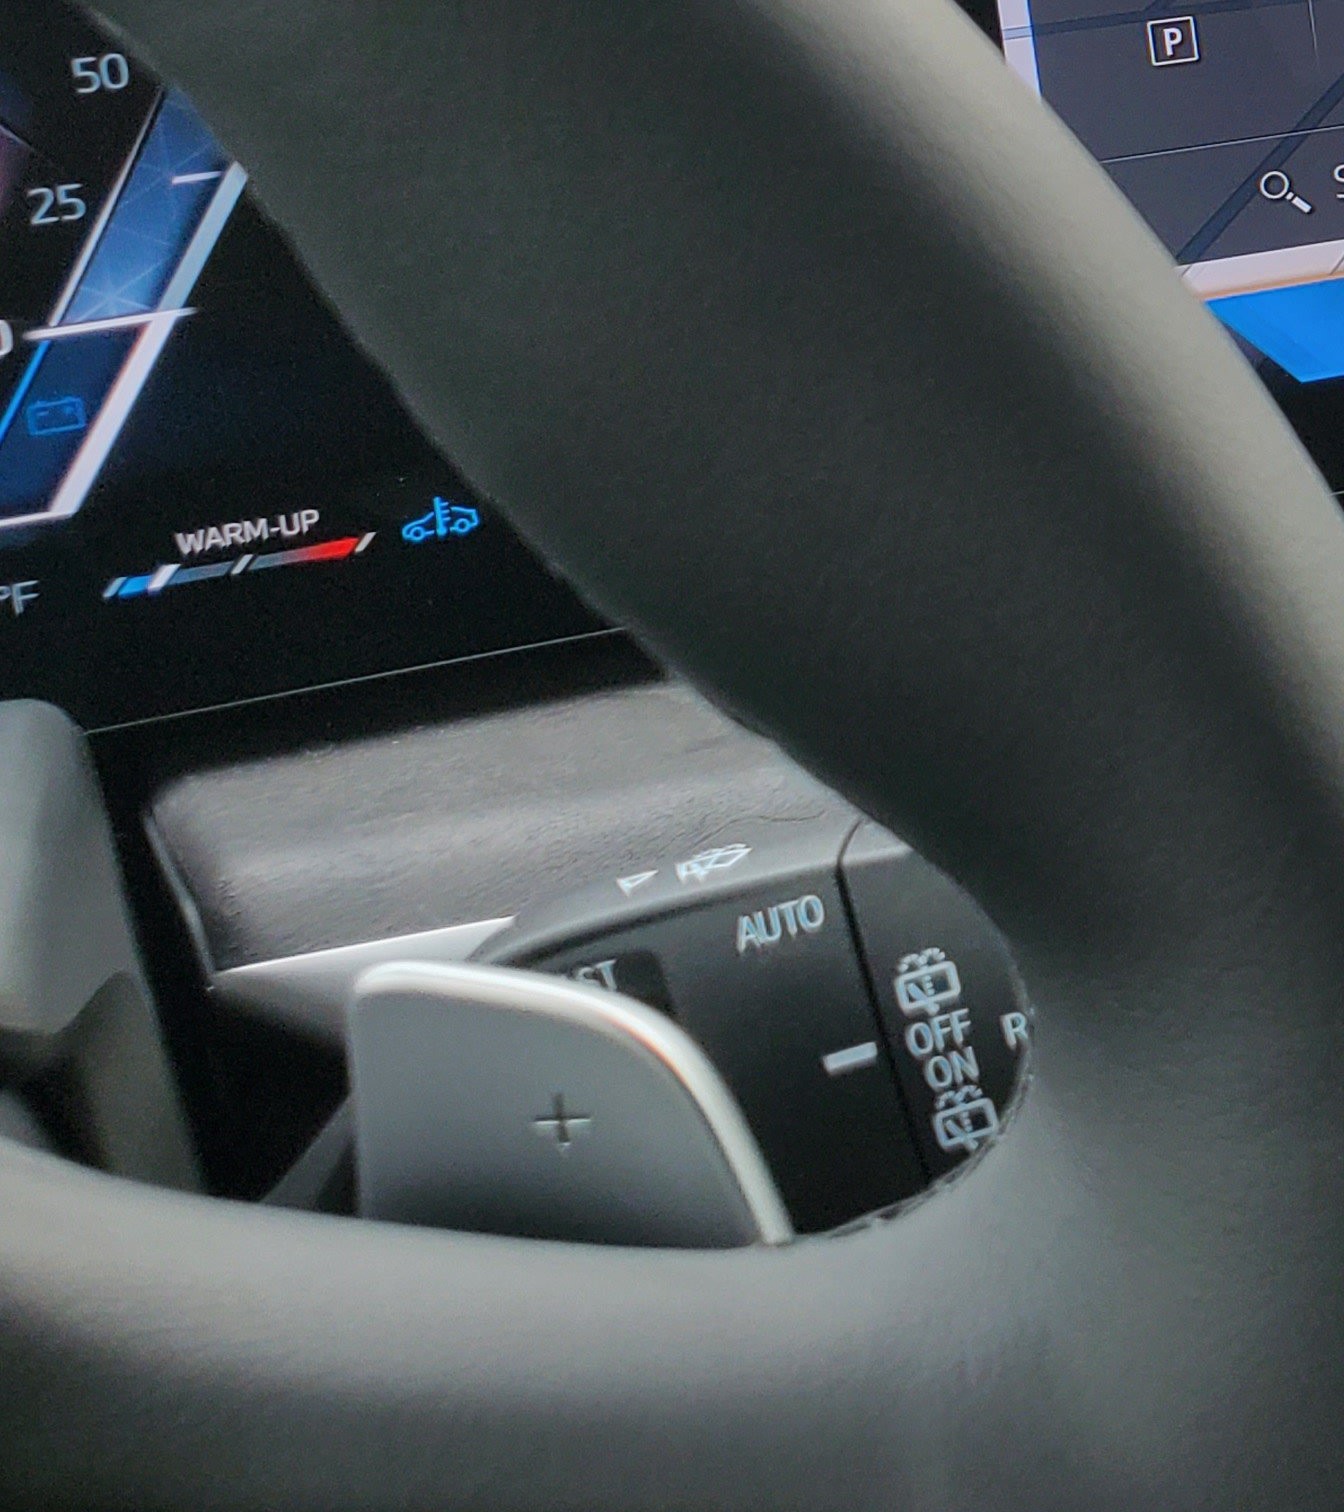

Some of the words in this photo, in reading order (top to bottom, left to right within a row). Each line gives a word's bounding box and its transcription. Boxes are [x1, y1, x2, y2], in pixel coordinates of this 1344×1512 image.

[1163, 28, 1183, 56] P
[71, 53, 129, 93] 50
[27, 183, 87, 226] 25
[174, 508, 320, 556] WARM-UP
[736, 895, 825, 953] AUTO
[905, 1007, 972, 1057] OFF
[925, 1046, 980, 1092] ON
